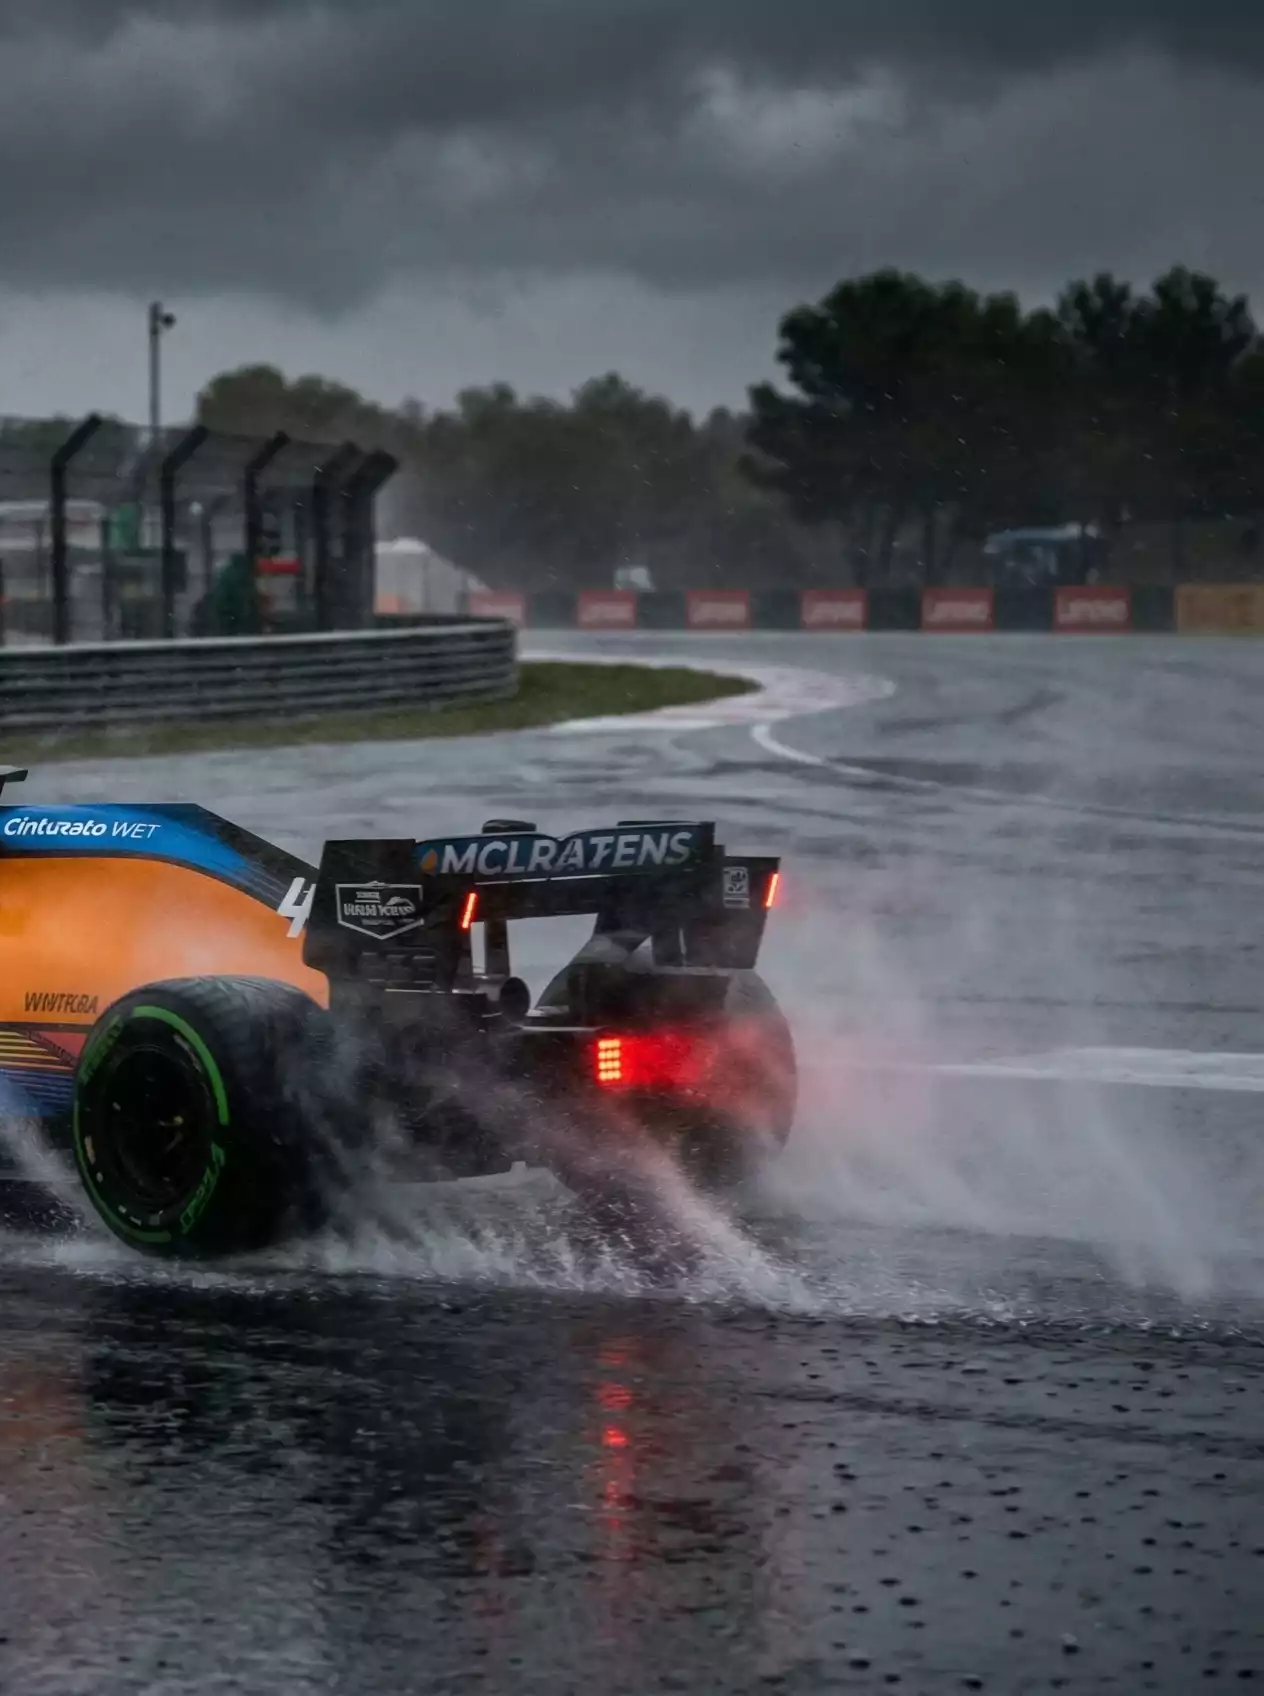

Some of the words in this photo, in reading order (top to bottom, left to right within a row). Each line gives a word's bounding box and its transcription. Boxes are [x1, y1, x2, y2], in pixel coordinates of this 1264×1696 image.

[4, 817, 107, 836] Cinturato
[111, 821, 161, 839] WET
[277, 877, 317, 938] 4
